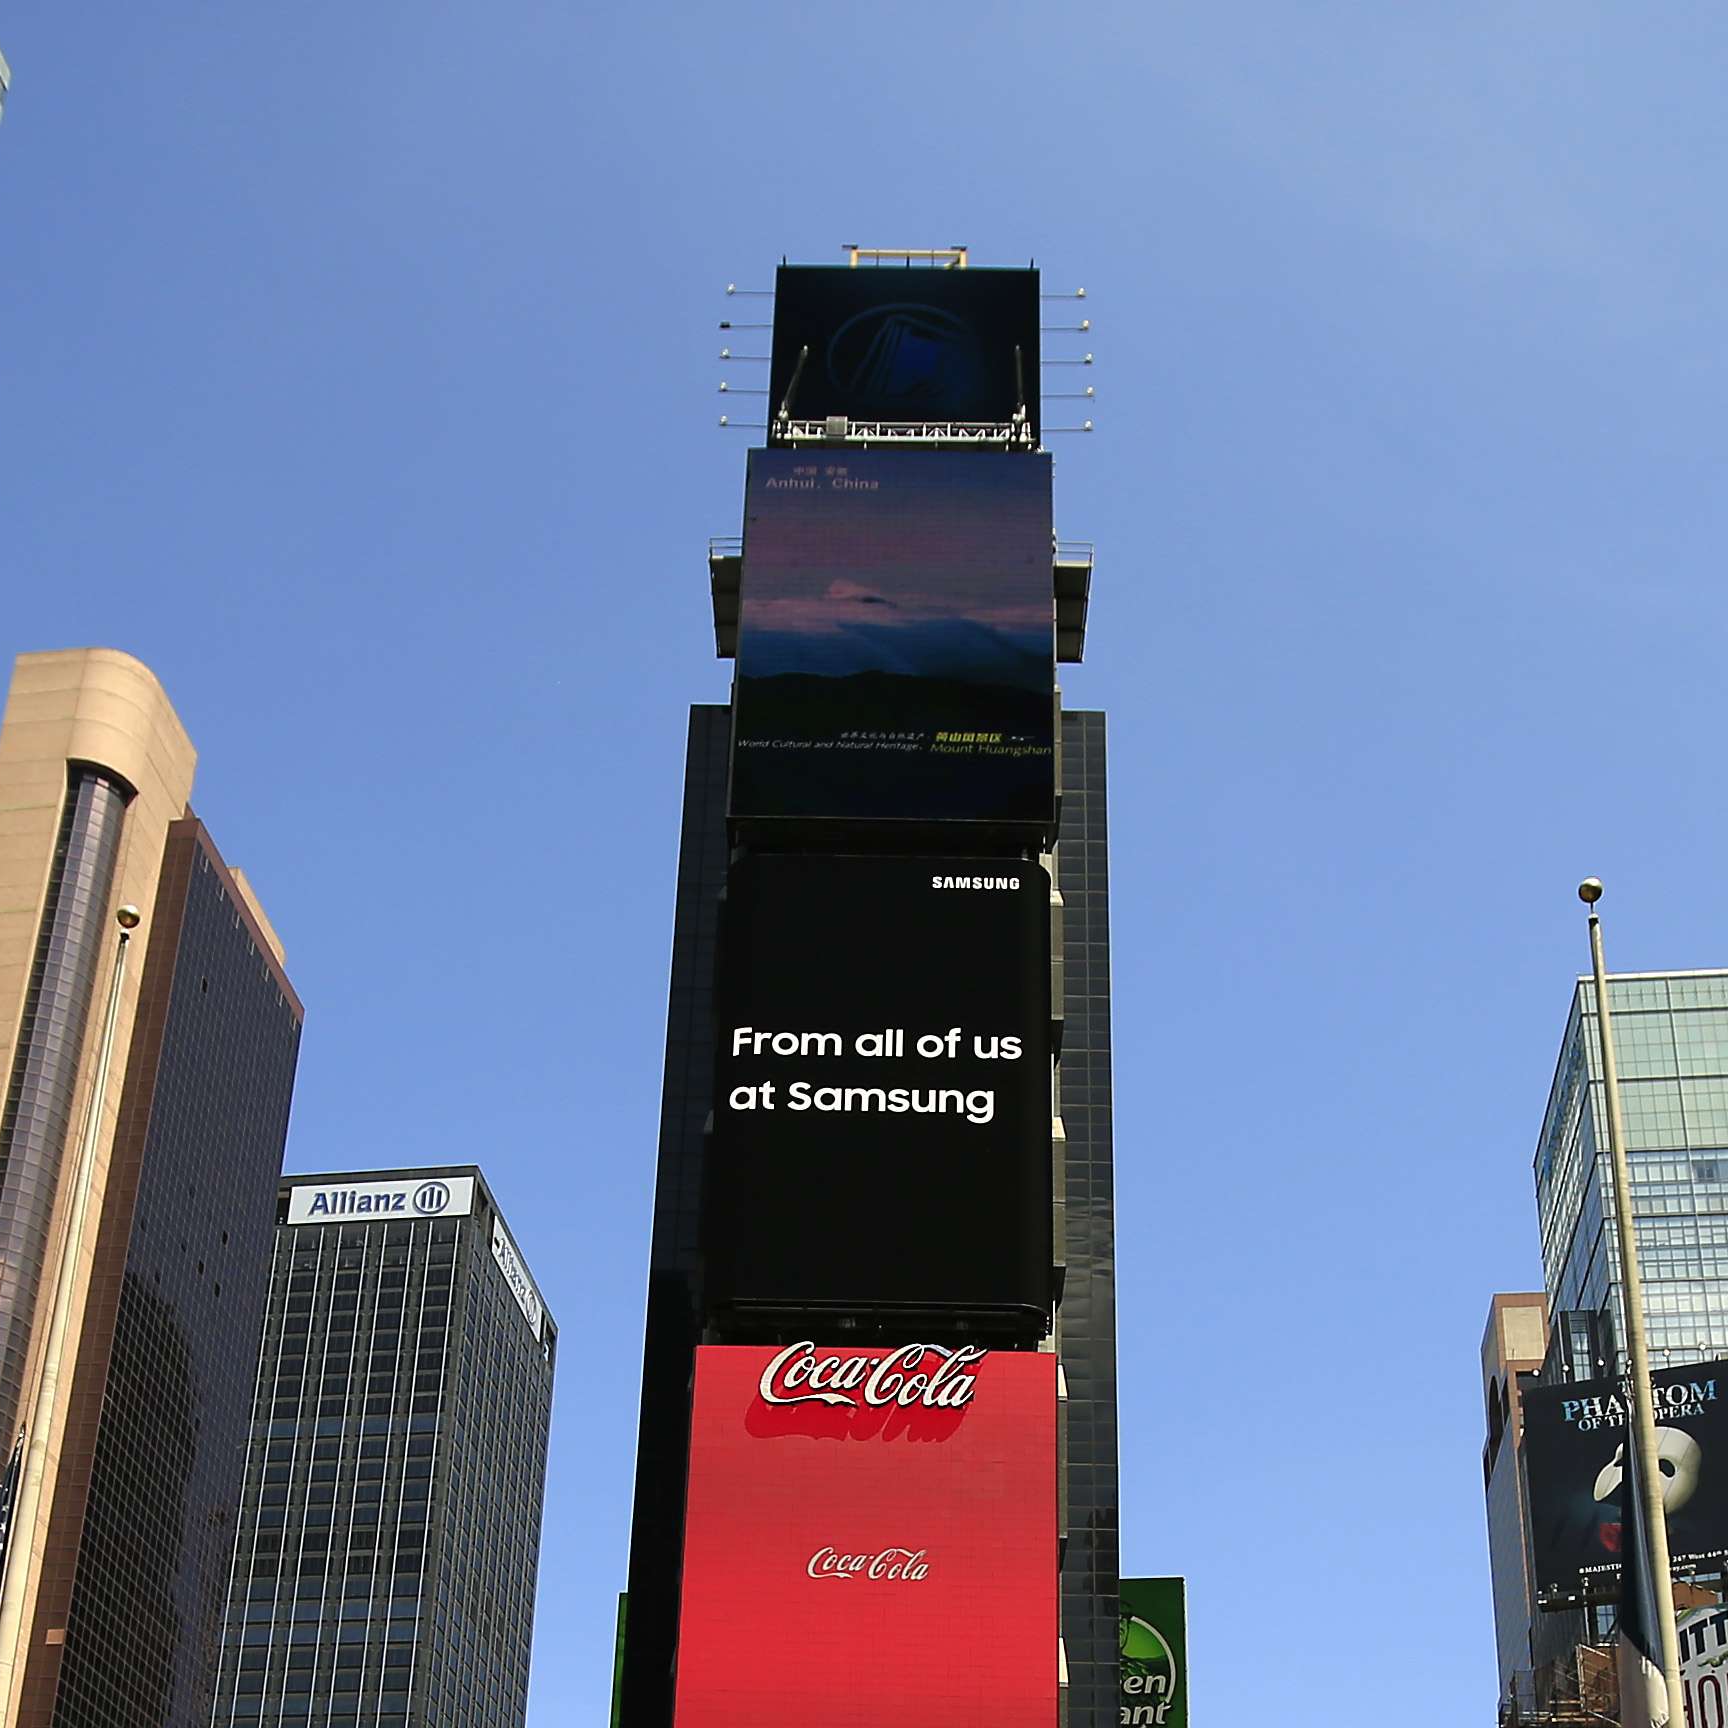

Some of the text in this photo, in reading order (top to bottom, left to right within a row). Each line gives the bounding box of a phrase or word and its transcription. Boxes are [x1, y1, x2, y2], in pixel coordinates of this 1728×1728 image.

[832, 477, 879, 490] China
[737, 738, 1052, 758] World Cultural and Natural Mount Huangshan
[932, 876, 1020, 890] SAMSUNG
[732, 1027, 1023, 1060] From all of us
[729, 1081, 995, 1125] at Samsung
[307, 1190, 406, 1217] Allianz
[759, 1340, 987, 1407] Coca-Cola
[1561, 1379, 1719, 1422] PHATOM
[1578, 1415, 1603, 1432] OF
[807, 1546, 929, 1581] Coca-Cola
